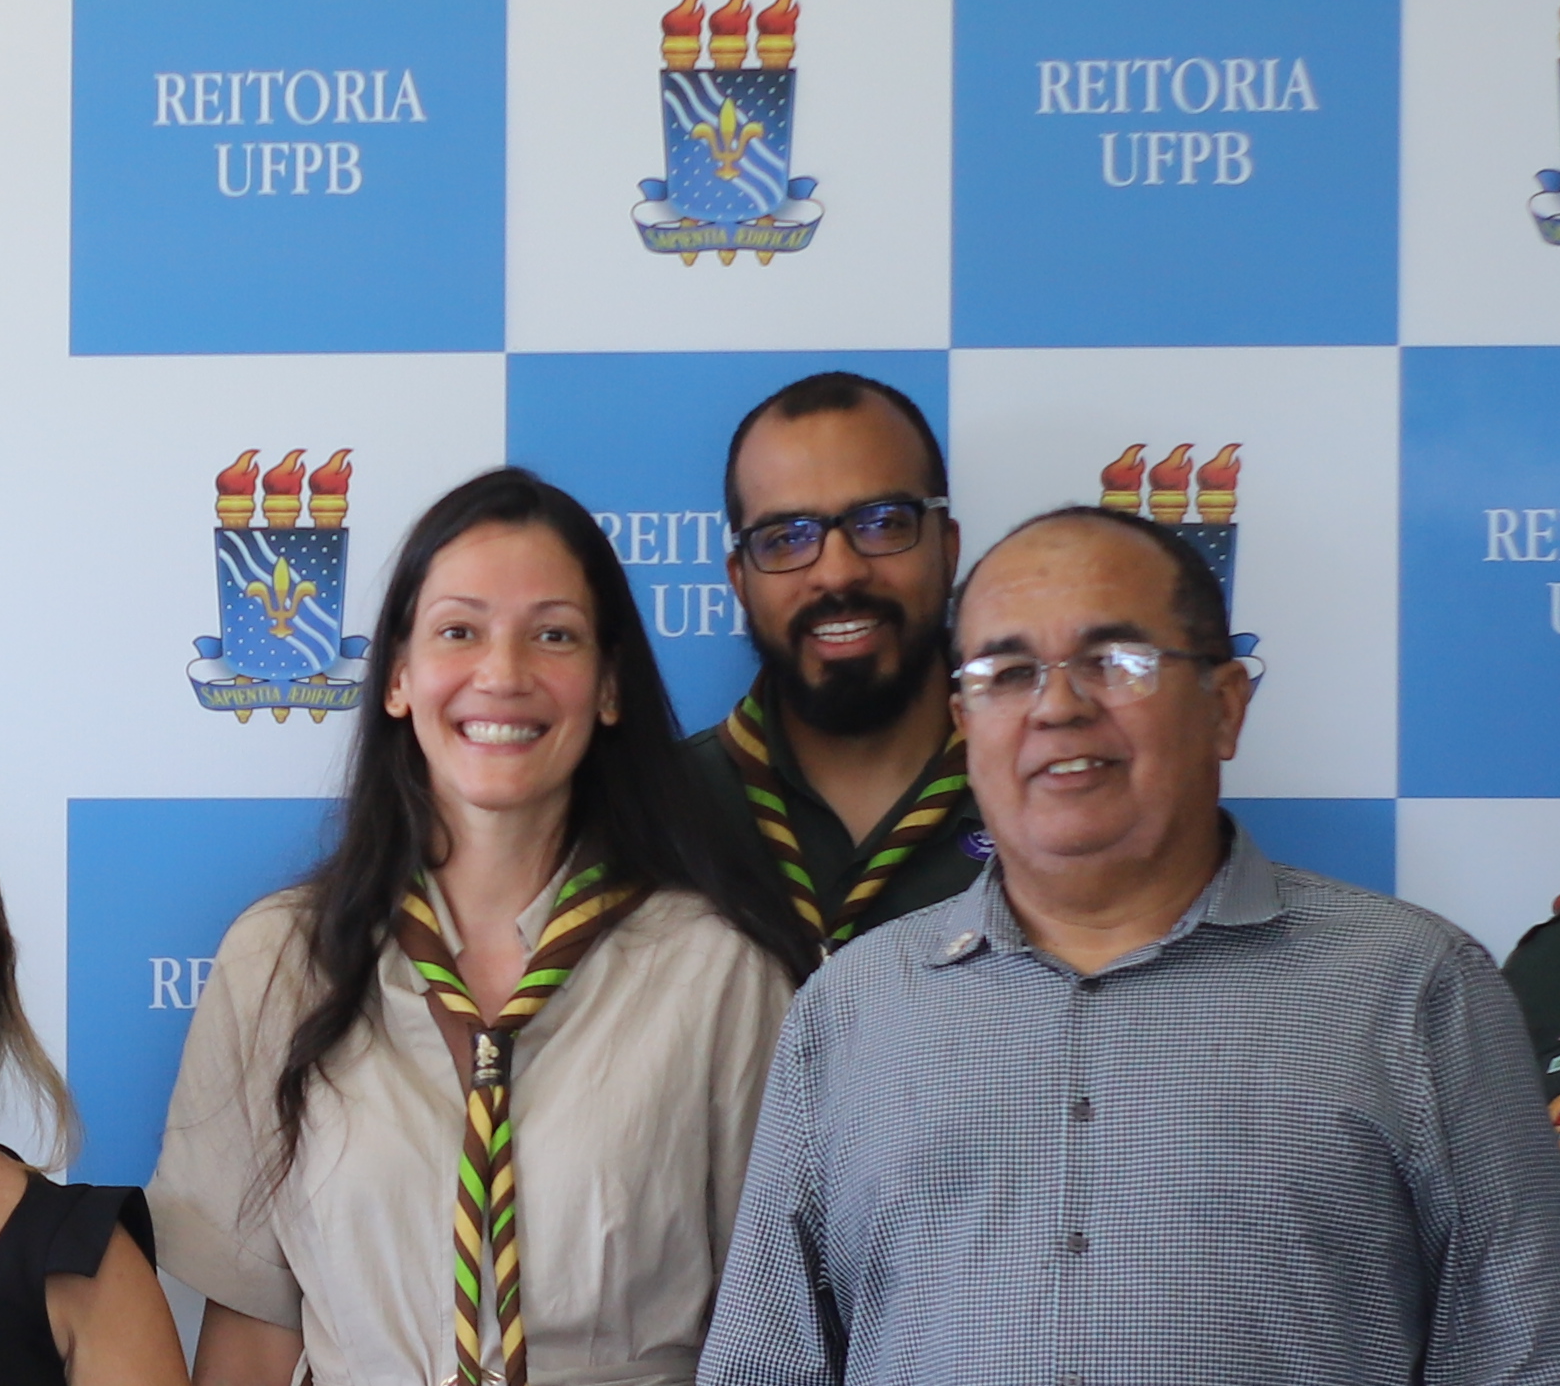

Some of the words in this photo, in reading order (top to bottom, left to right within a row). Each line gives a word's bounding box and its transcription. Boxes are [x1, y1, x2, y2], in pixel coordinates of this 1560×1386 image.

[153, 68, 428, 126] REITORIA
[1036, 56, 1320, 114] REITORIA
[213, 141, 363, 197] UFPB
[1098, 131, 1253, 188] UFPB
[591, 510, 736, 564] REIT
[650, 583, 746, 638] UF
